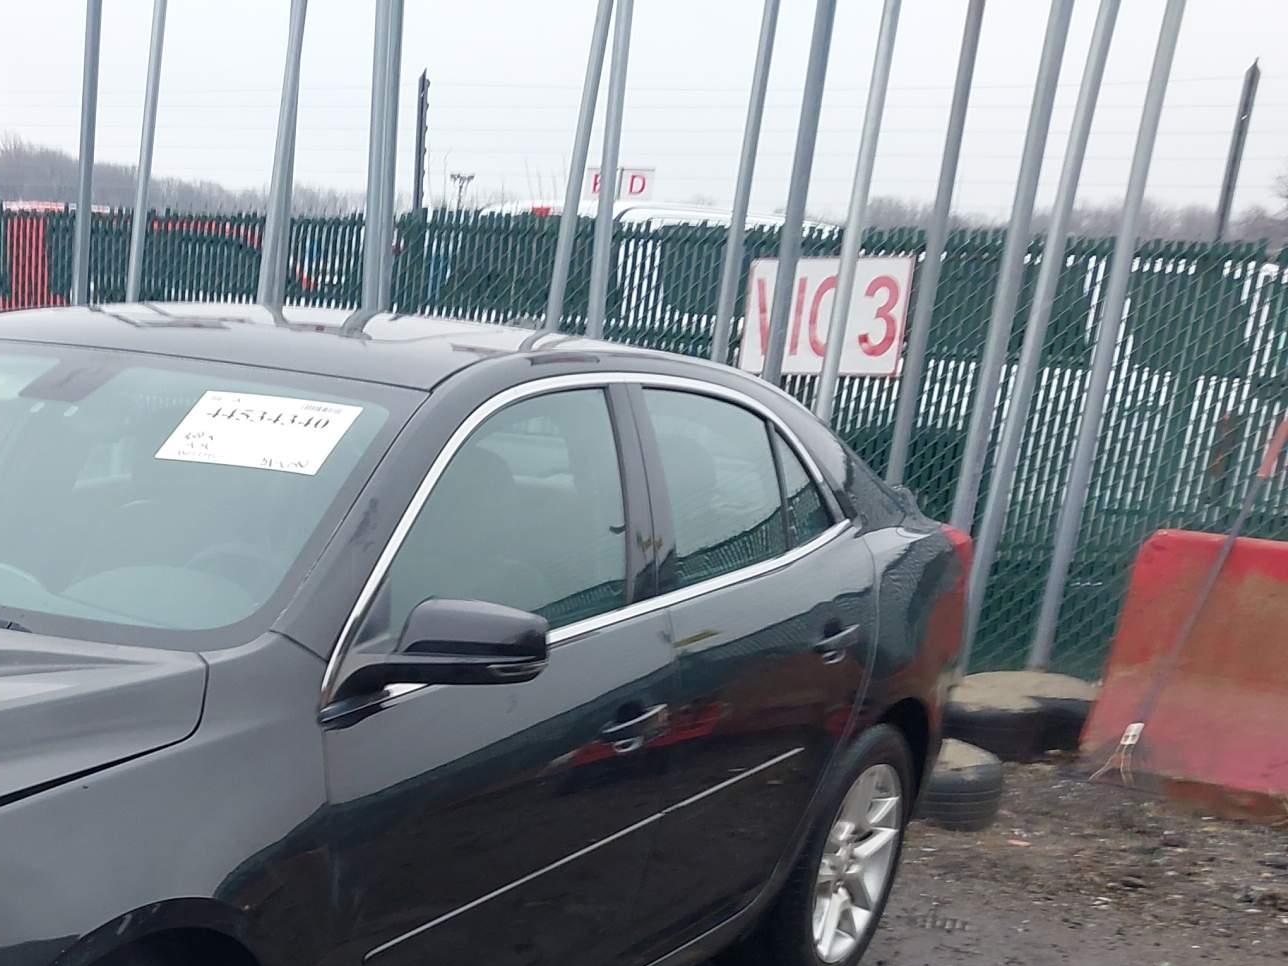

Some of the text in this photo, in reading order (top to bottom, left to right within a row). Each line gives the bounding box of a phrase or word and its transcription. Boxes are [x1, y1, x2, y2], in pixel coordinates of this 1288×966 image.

[628, 174, 647, 195] D
[858, 275, 899, 357] 3
[207, 407, 330, 429] 44534340
